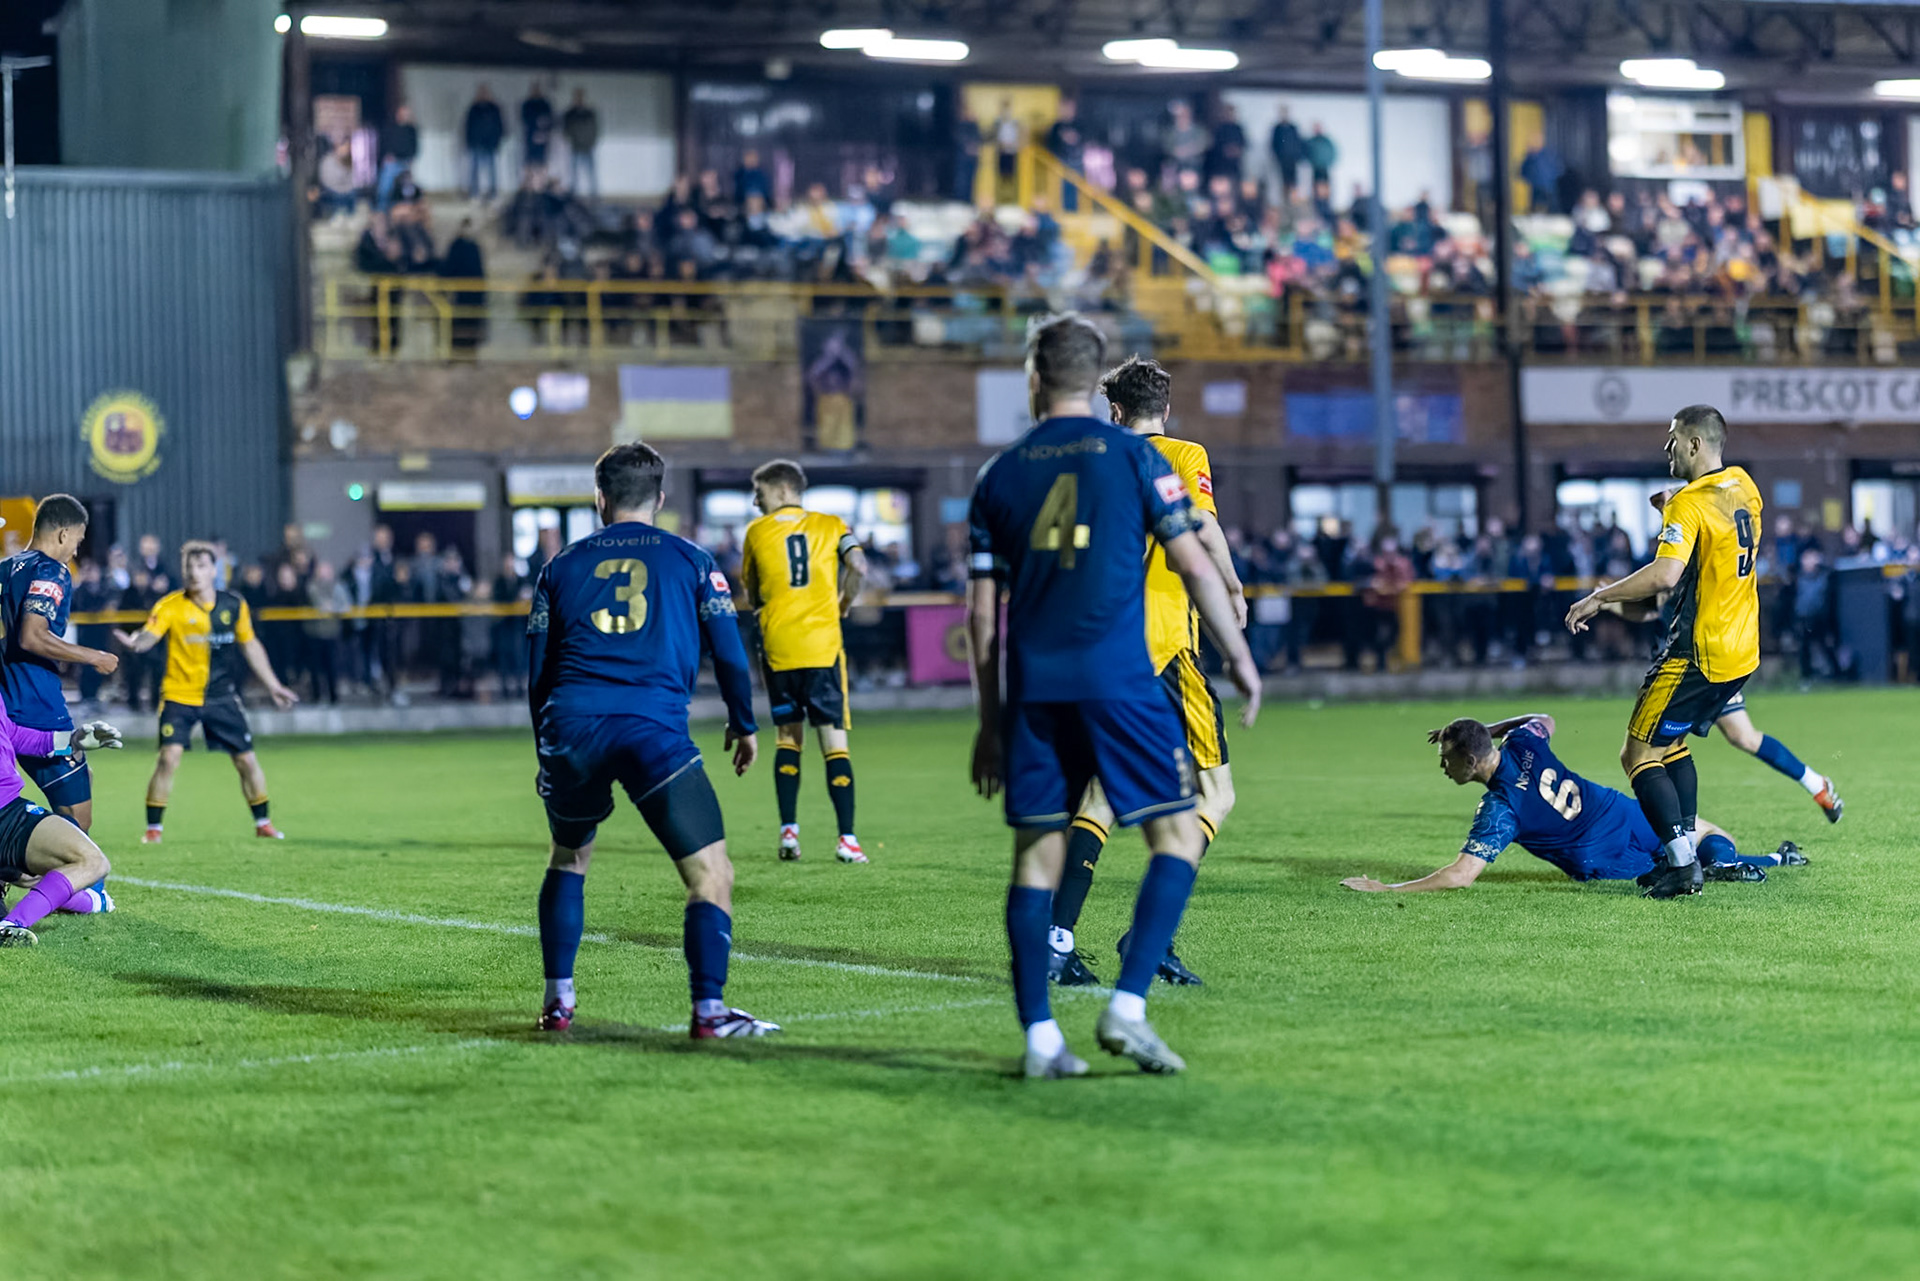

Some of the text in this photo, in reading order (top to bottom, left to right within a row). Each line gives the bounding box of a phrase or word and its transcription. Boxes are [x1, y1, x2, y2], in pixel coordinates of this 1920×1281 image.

[1731, 379, 1877, 412] PRESCOT
[586, 535, 662, 549] Novelis
[1030, 472, 1090, 570] 4
[1734, 508, 1756, 578] 9
[786, 533, 810, 588] 8
[591, 558, 648, 634] 3
[1539, 767, 1582, 821] 6
